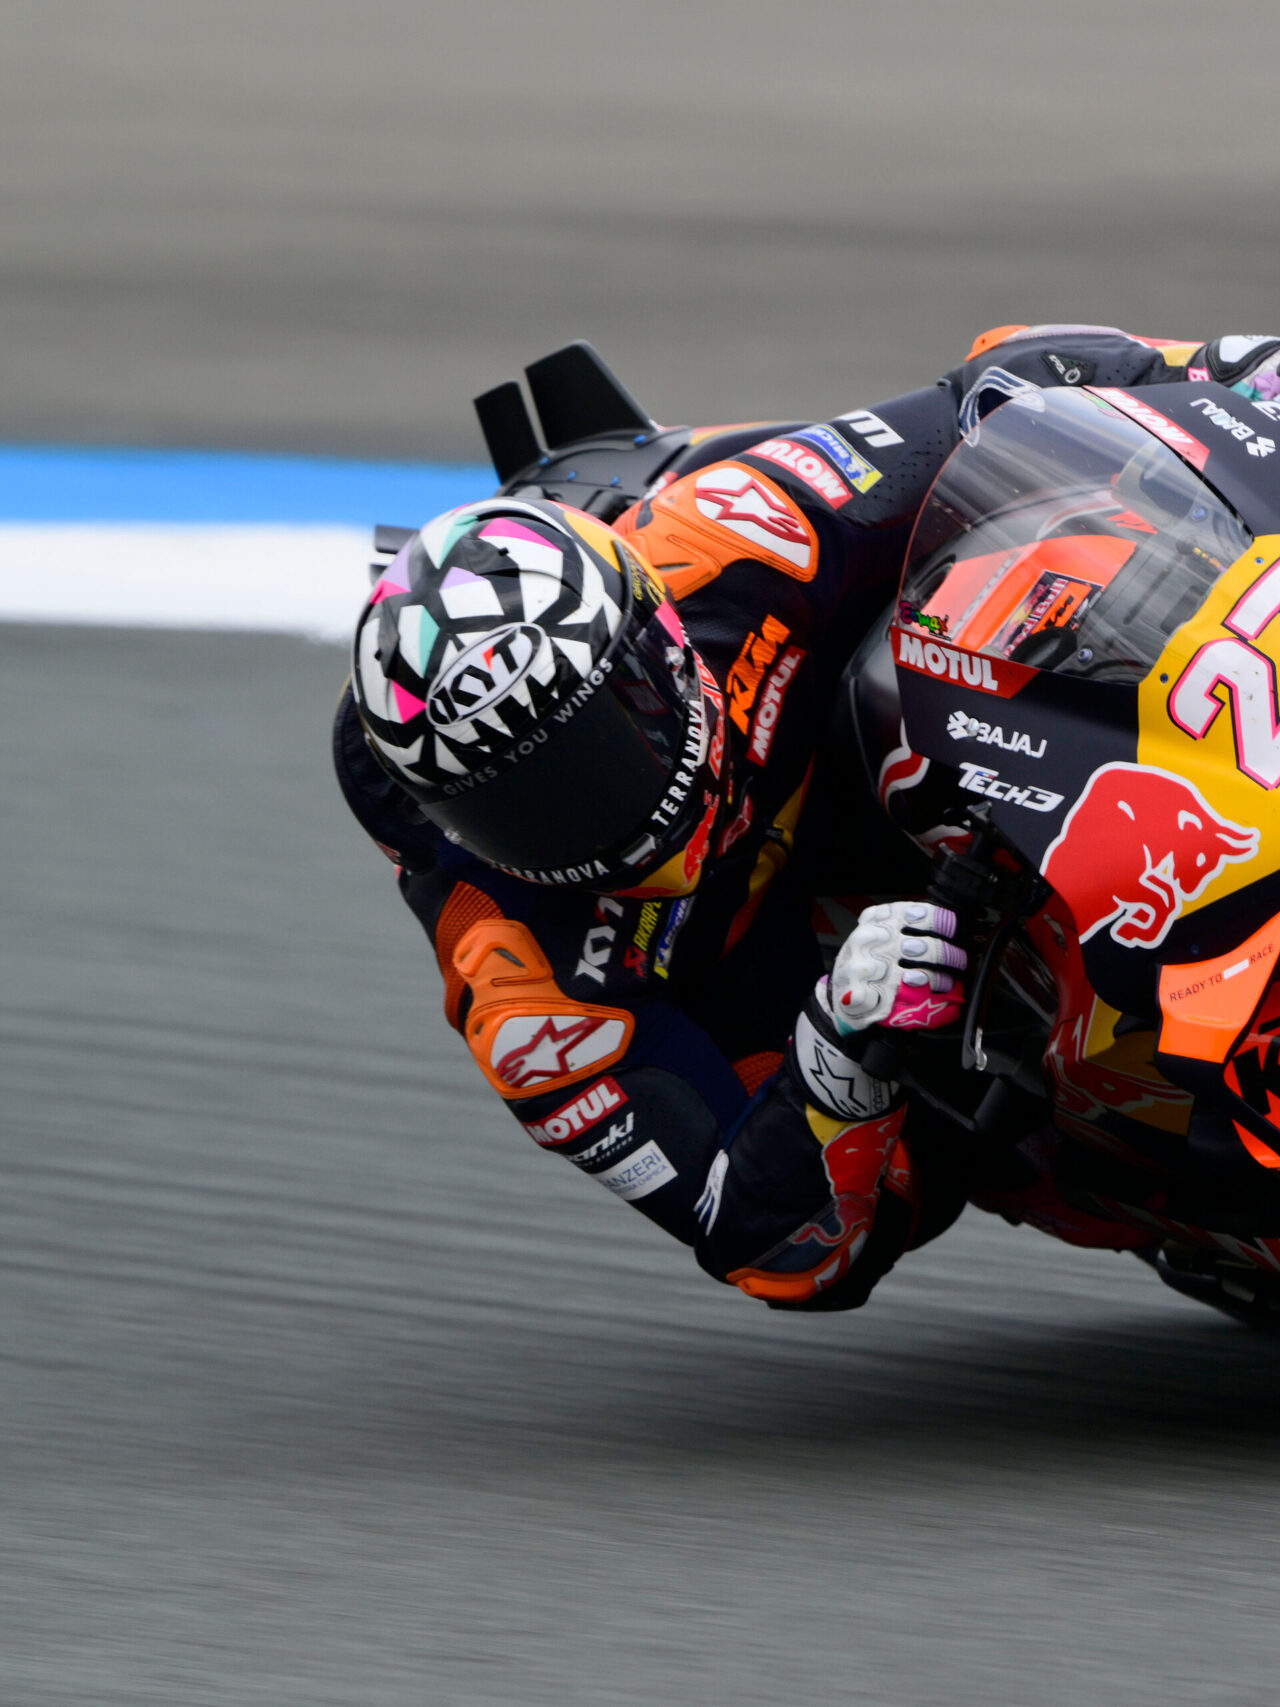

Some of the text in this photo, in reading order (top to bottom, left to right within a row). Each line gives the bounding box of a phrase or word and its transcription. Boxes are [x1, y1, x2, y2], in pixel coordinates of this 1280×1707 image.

[758, 439, 848, 500] MOTUL
[429, 632, 521, 725] KYT
[727, 614, 791, 736] KTM
[899, 633, 999, 692] MOTUL
[443, 657, 614, 796] GIVES YOU WINGS
[753, 651, 801, 761] MOTUL
[651, 699, 702, 828] TERRANOVA
[958, 762, 1065, 813] TECH3
[1169, 943, 1274, 1002] READY TO RACE
[526, 1083, 621, 1143] MOTUL
[603, 1151, 662, 1189] ANZERI
